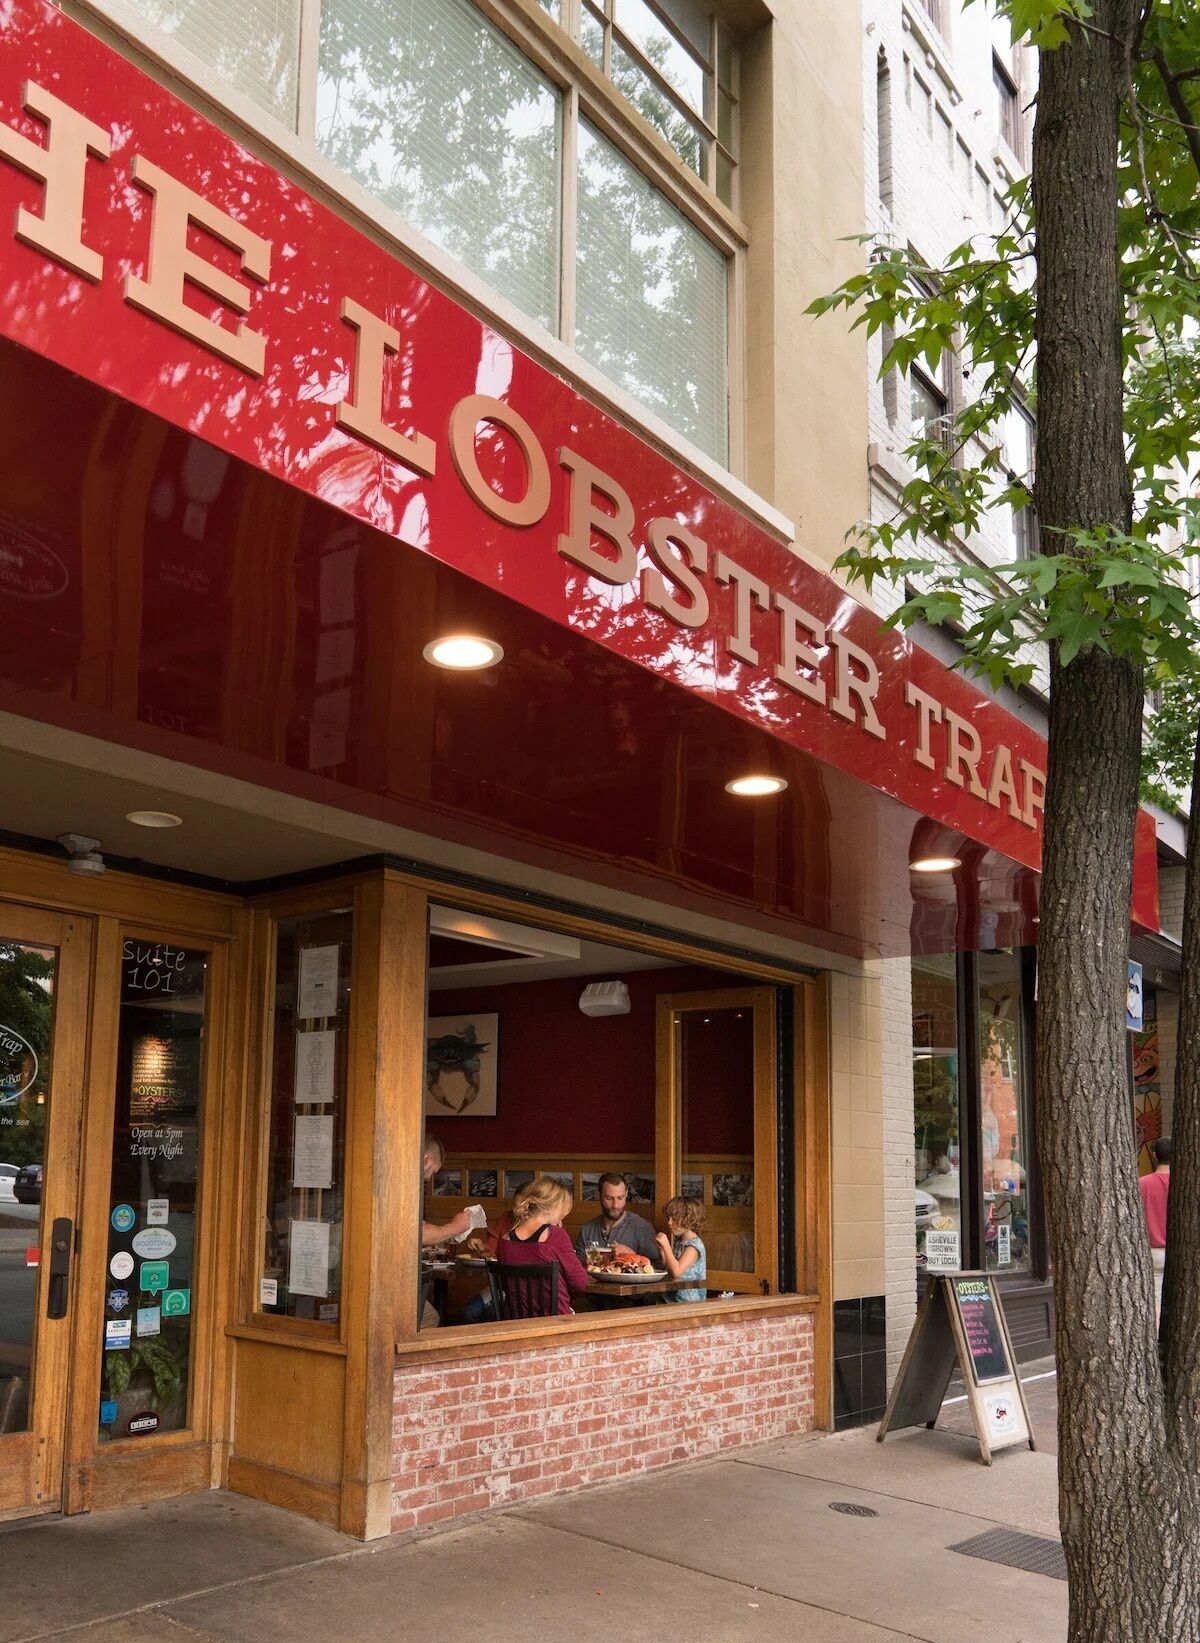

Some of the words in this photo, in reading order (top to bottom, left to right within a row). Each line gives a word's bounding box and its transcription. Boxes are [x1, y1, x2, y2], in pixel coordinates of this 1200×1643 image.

[334, 295, 887, 741] LOBSTER
[903, 682, 1047, 829] TRAP
[122, 940, 186, 971] Suite
[127, 967, 177, 993] 101
[1, 1117, 14, 1126] the
[15, 1118, 30, 1126] sea
[131, 1126, 154, 1143] Open
[154, 1129, 164, 1138] at
[165, 1127, 184, 1143] 5pm
[130, 1143, 158, 1160] Every
[159, 1142, 185, 1160] Night
[928, 1236, 957, 1245] ASHEVILLE
[928, 1256, 940, 1265] BUY
[940, 1256, 958, 1265] LOCAL
